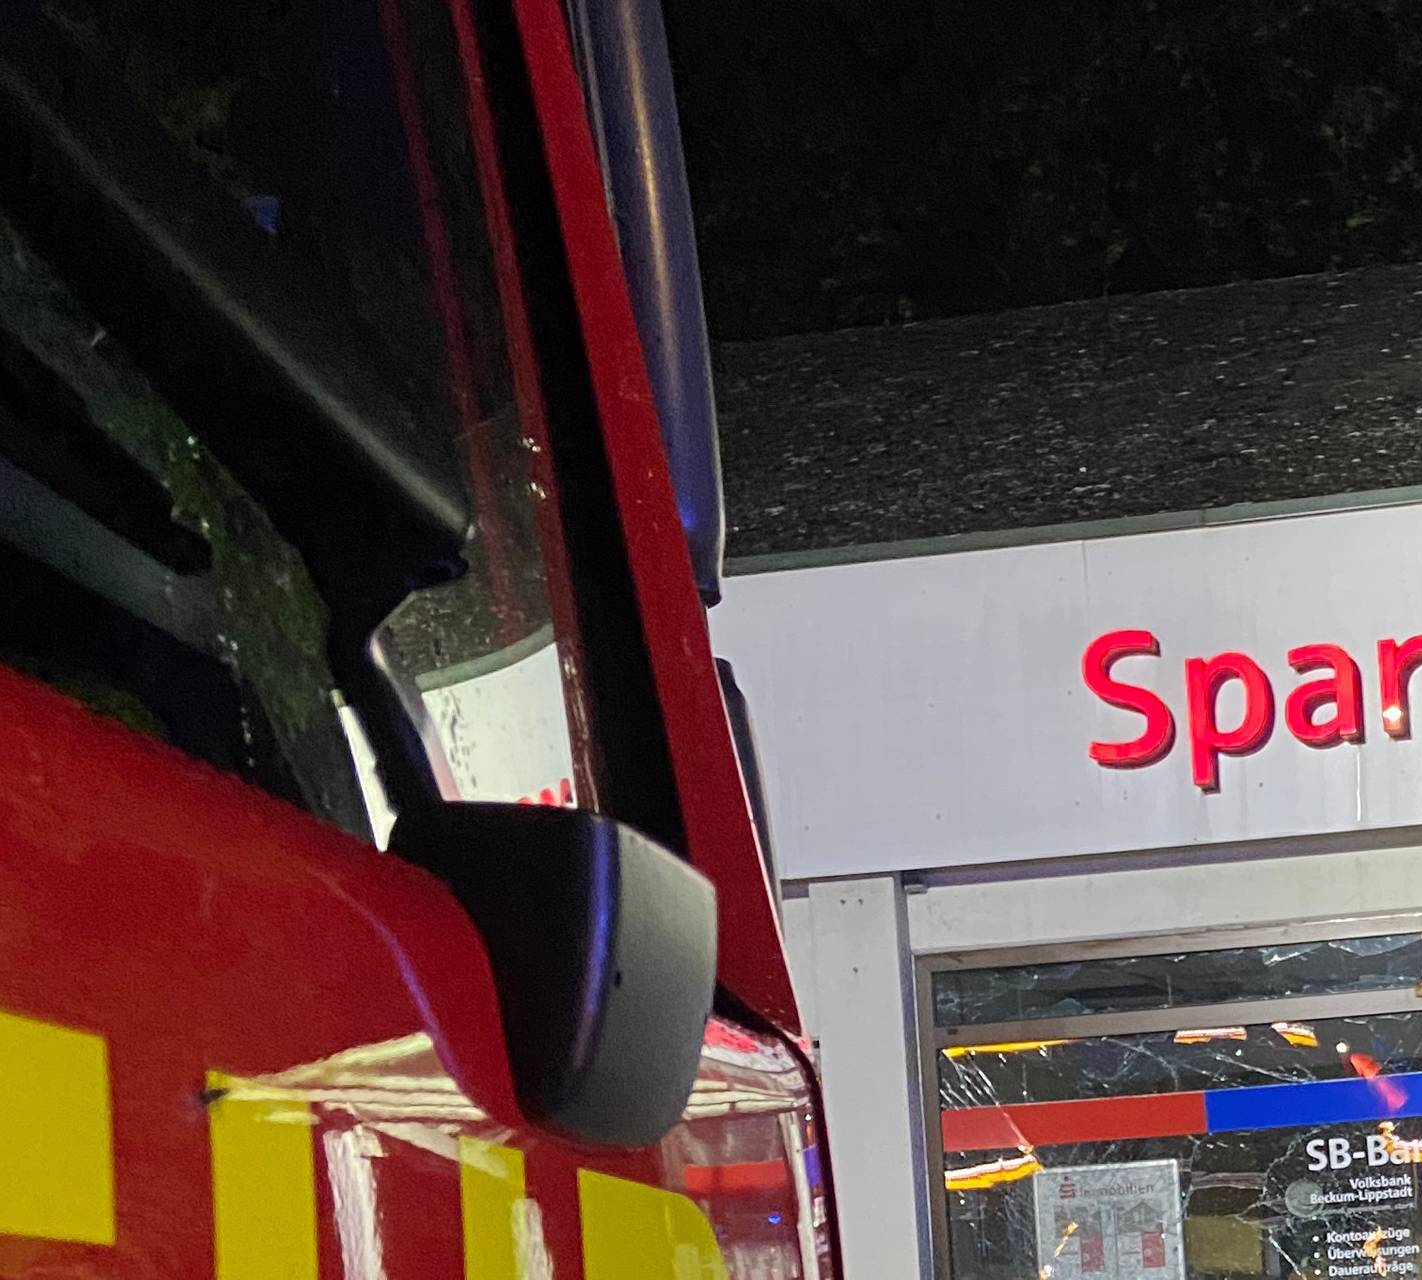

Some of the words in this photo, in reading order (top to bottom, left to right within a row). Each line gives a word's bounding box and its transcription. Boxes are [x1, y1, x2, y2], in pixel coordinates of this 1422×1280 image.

[1349, 1173, 1412, 1190] Volksbank
[1310, 1185, 1414, 1205] Beckum-Lippstadt
[1326, 1227, 1411, 1244] Kontoauzüge
[1327, 1243, 1420, 1260] Überwsungen
[1328, 1260, 1414, 1277] Dauerauräge
